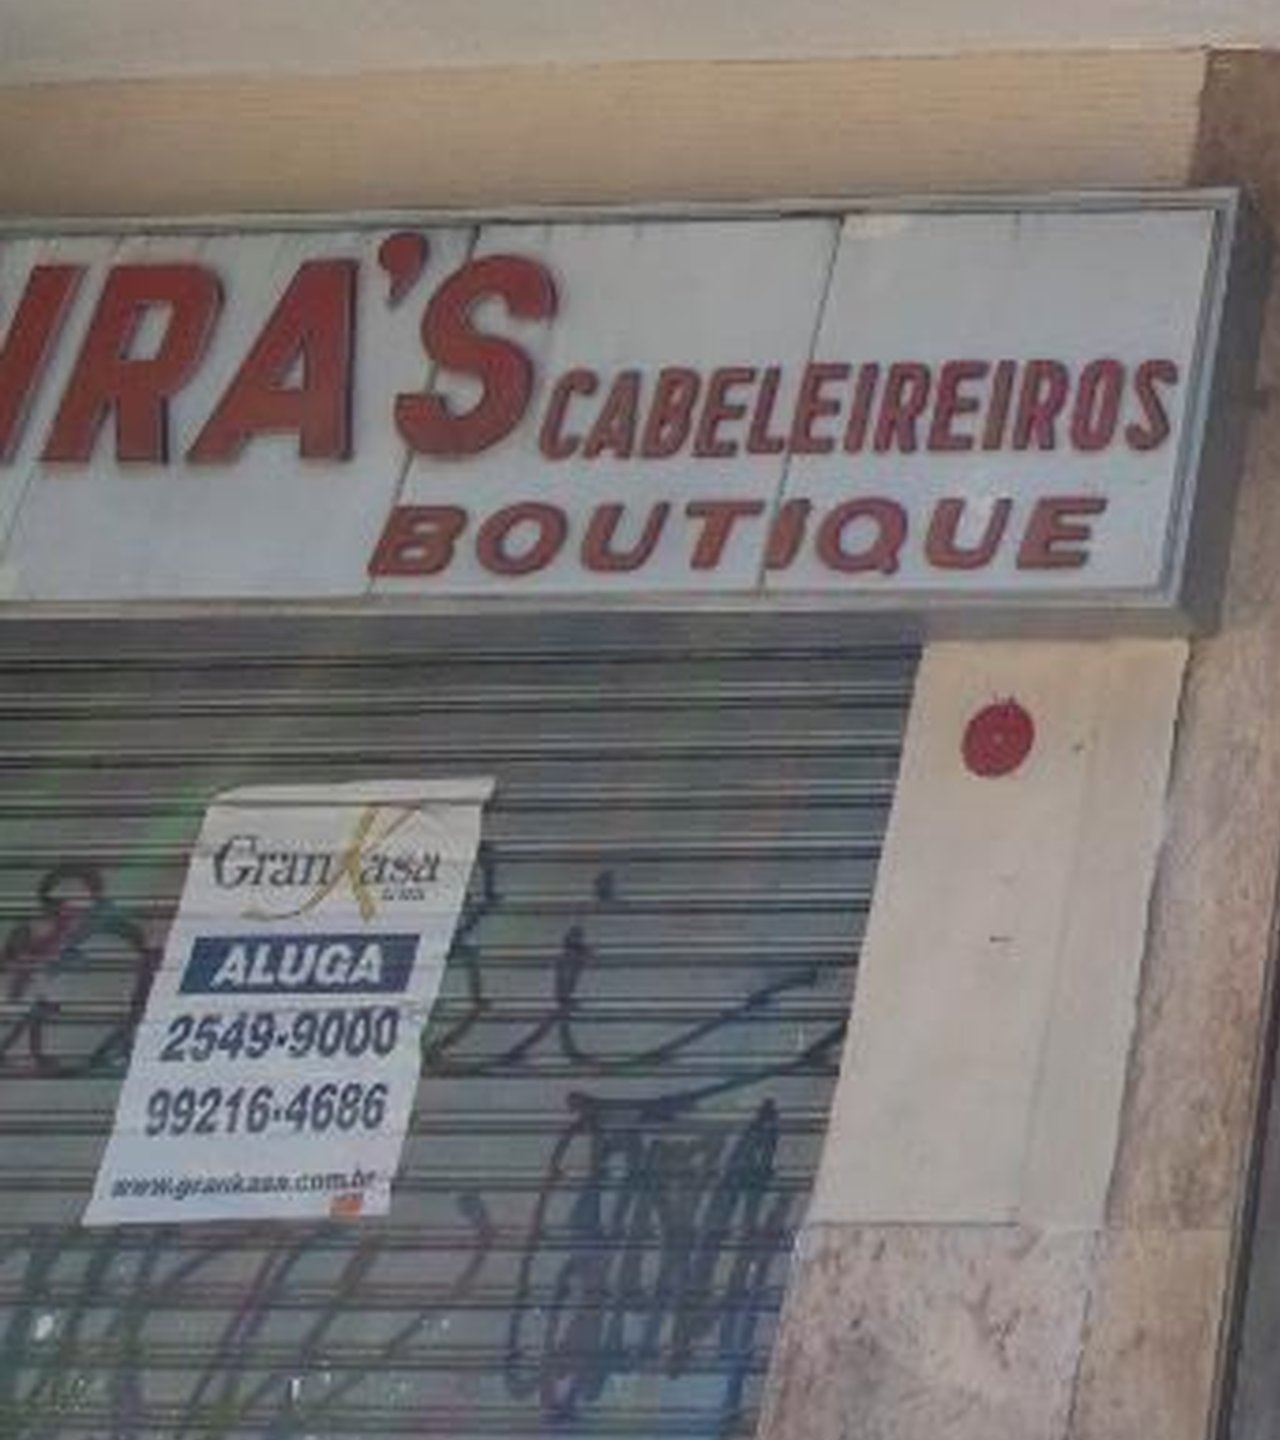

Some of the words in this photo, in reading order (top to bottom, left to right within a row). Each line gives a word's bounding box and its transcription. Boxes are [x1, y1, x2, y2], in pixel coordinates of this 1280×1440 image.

[538, 357, 1180, 461] CABELEIREIROS
[366, 495, 1109, 580] BOUTIQUE
[212, 944, 382, 986] ALUGA
[160, 1006, 400, 1063] 2549-9000
[144, 1084, 389, 1137] 99216-4686
